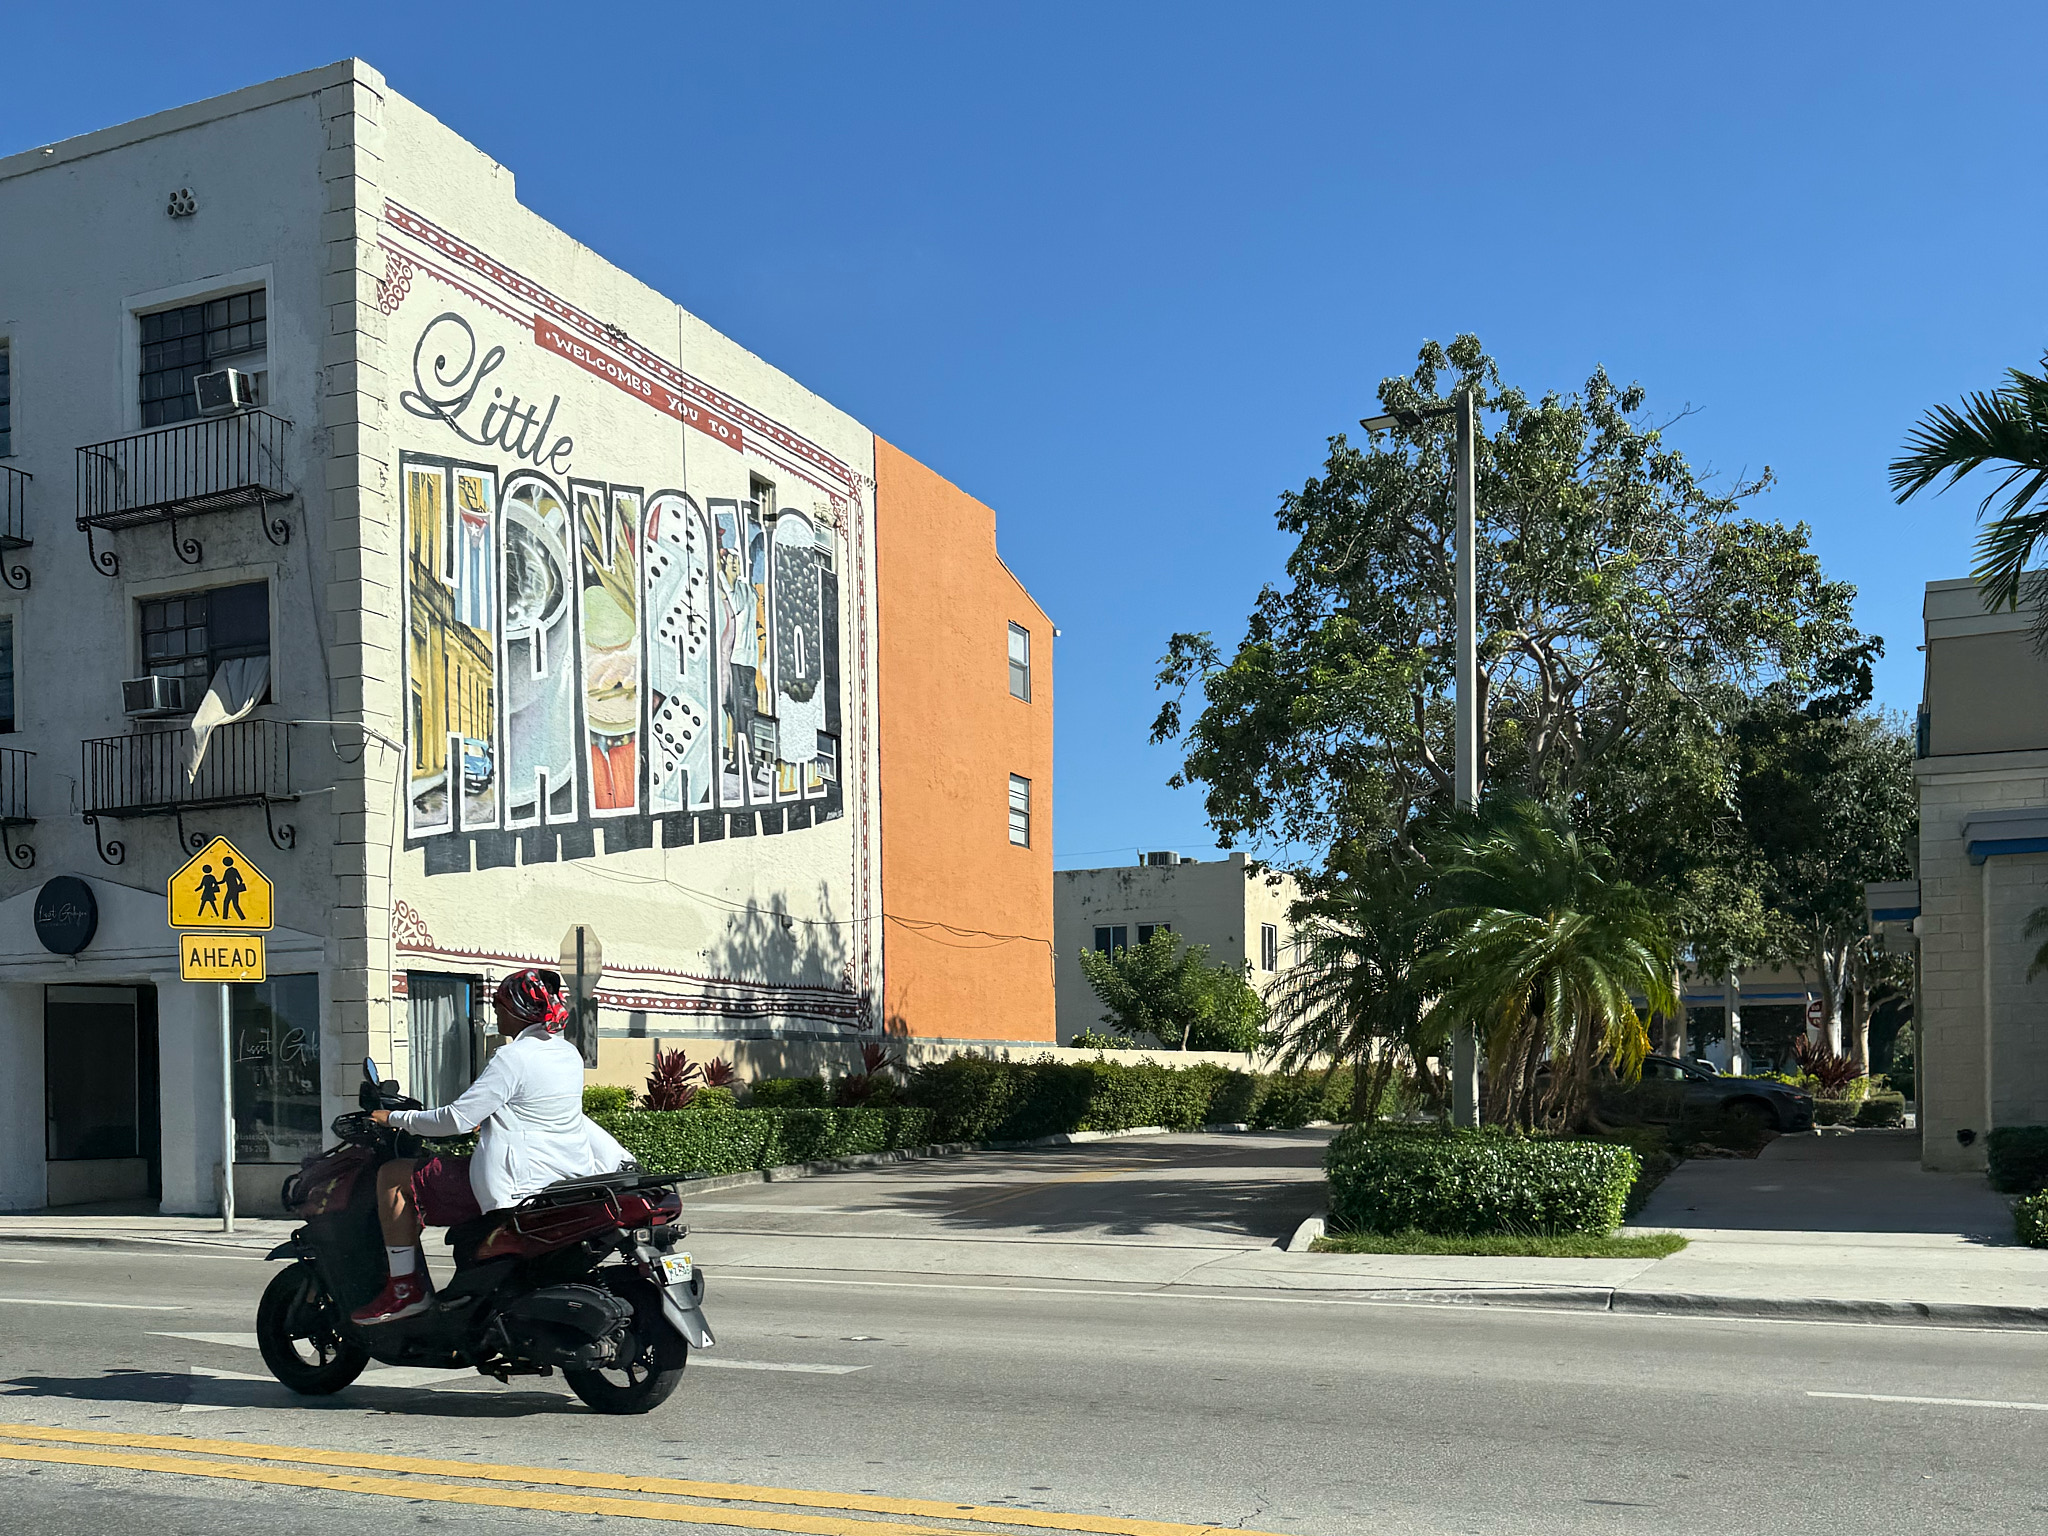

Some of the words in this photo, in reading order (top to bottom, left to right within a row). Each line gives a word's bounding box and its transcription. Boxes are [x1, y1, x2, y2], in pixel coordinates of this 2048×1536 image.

[400, 311, 573, 475] Little
[665, 393, 699, 422] YOU
[708, 418, 729, 438] TO
[400, 450, 842, 868] HAVANA
[189, 947, 257, 968] AHEAD
